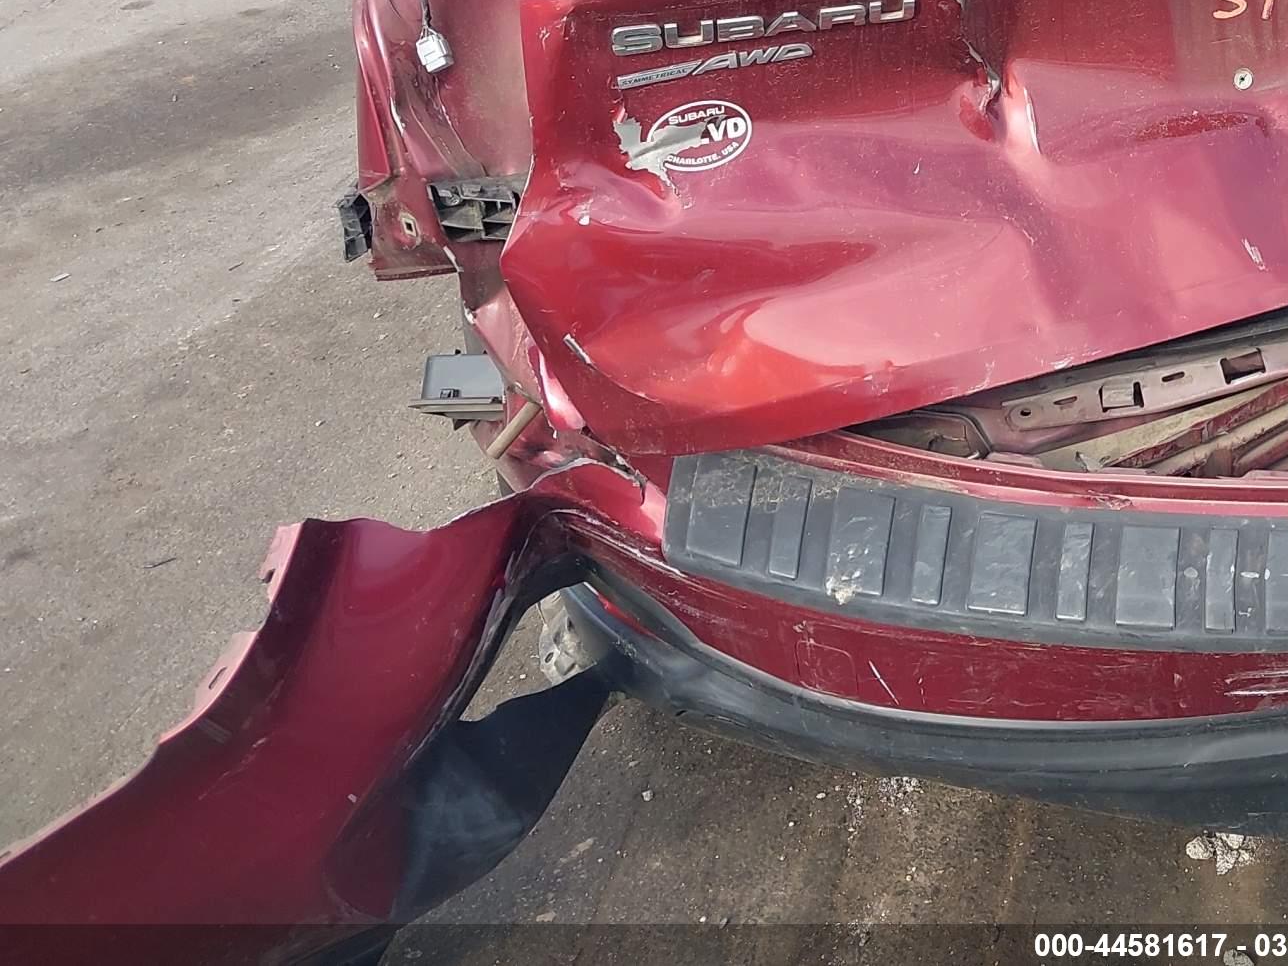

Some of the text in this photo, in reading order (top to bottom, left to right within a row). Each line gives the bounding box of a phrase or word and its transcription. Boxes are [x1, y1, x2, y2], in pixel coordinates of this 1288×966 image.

[621, 42, 814, 86] SYMMETRICAL AWD
[668, 106, 725, 126] SUBARU
[721, 141, 740, 156] USA
